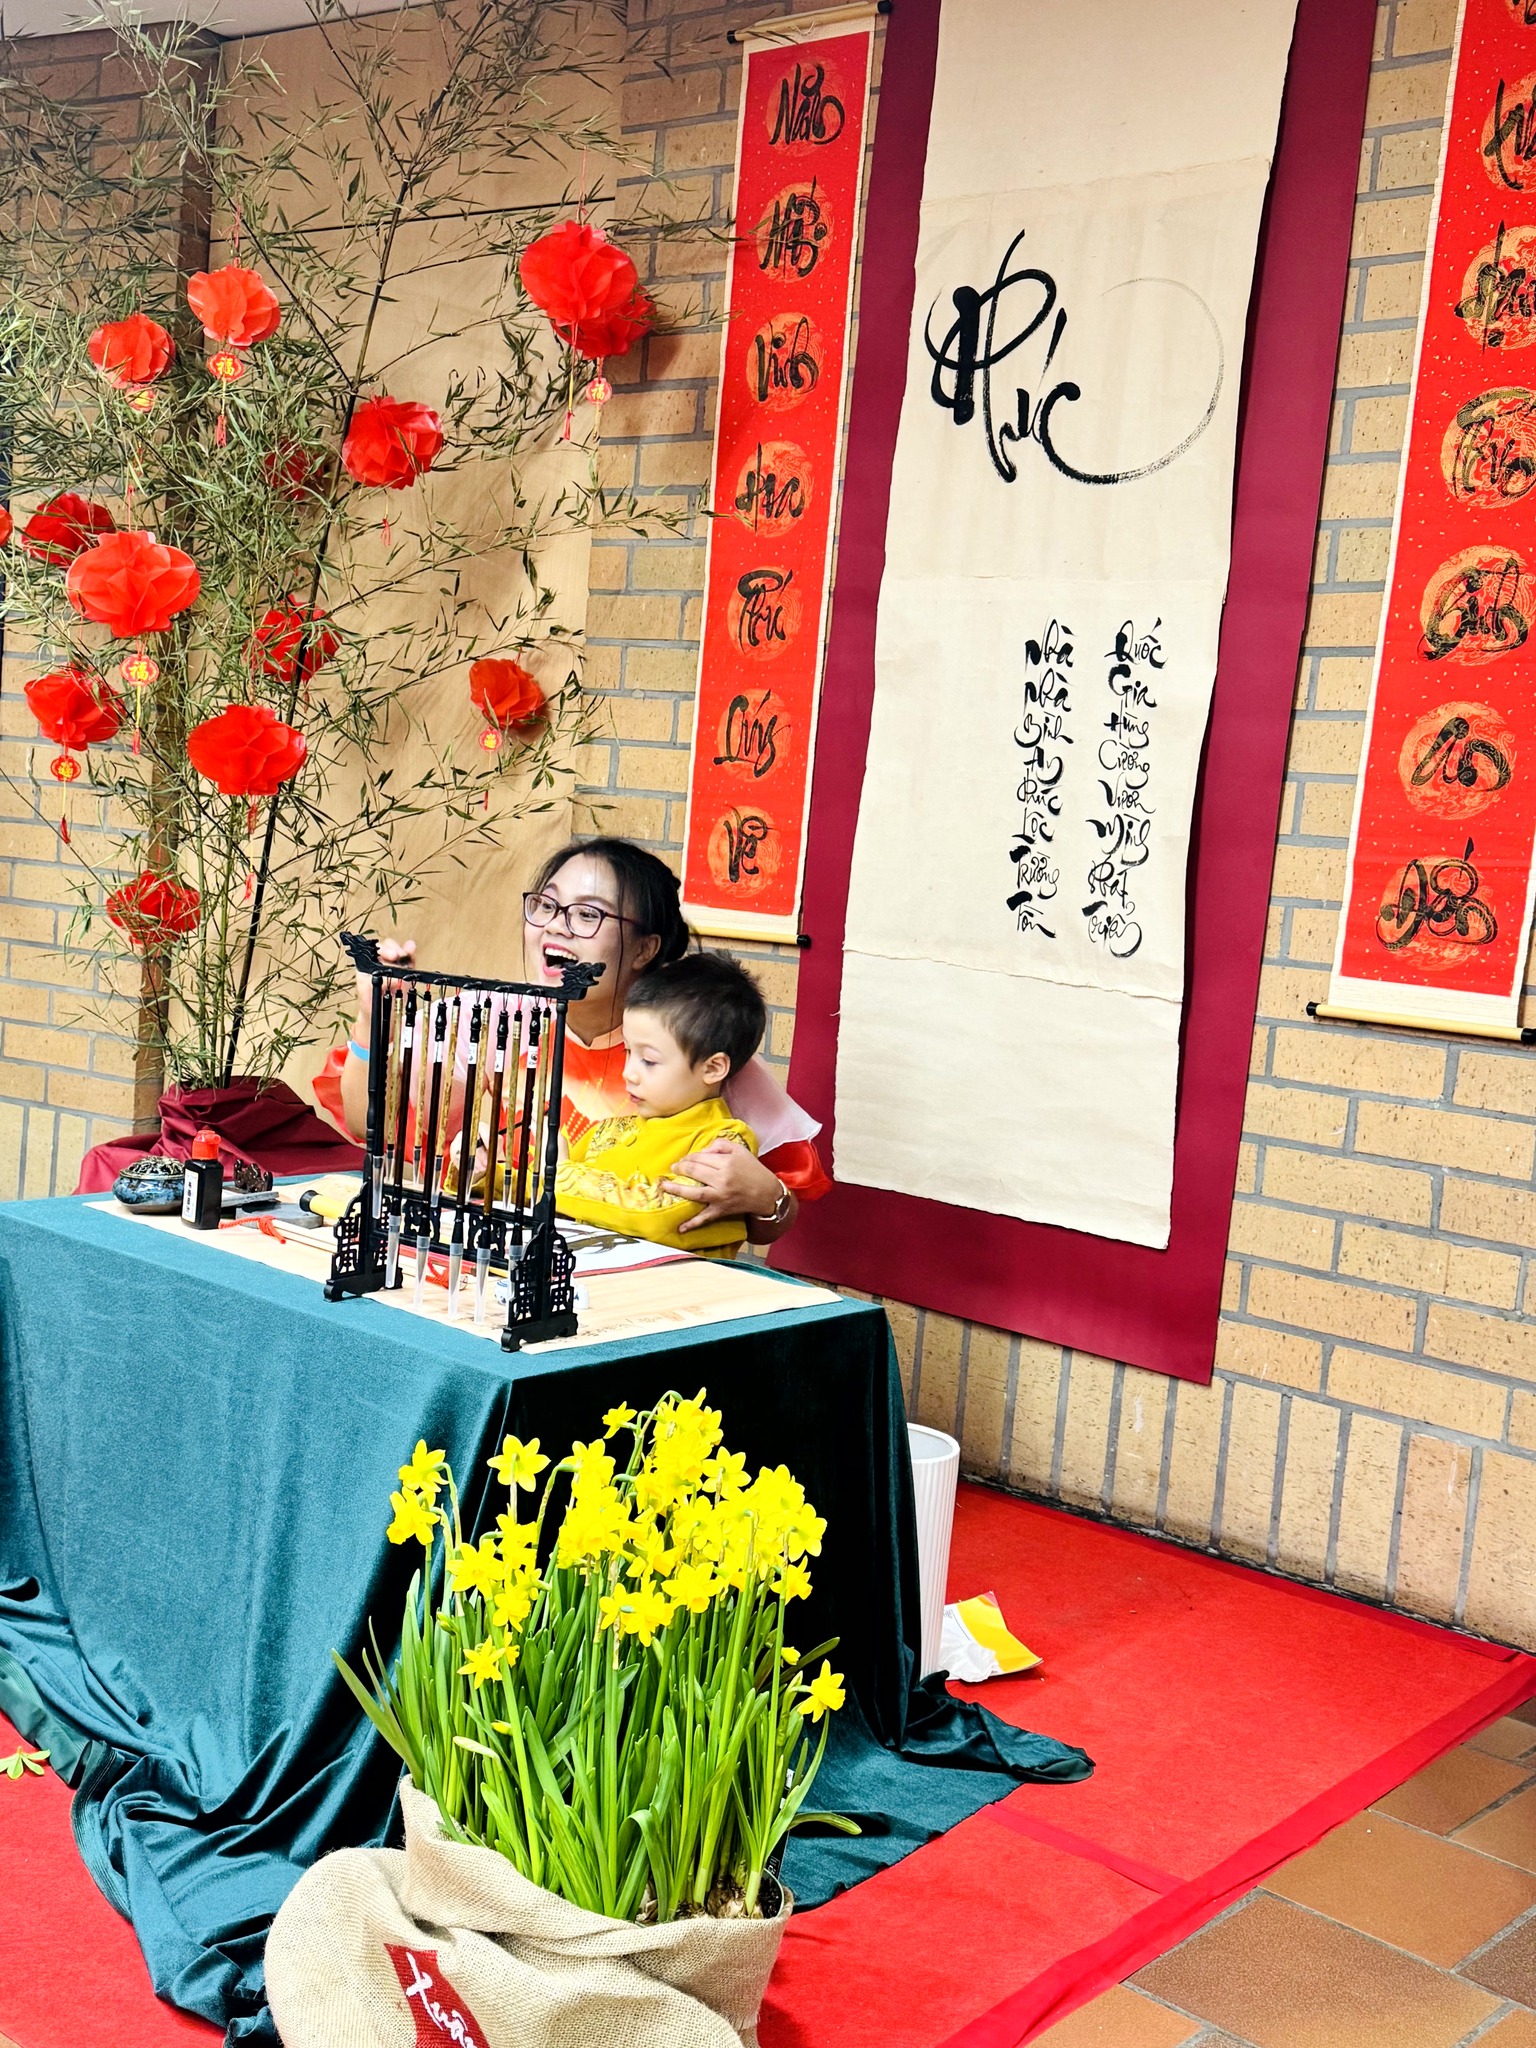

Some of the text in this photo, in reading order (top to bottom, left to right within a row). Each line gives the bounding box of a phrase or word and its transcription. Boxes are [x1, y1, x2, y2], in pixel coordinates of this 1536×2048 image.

[924, 228, 1224, 485] Phúc
[1025, 616, 1075, 671] Nhà
[1023, 668, 1073, 717] Nhà
[1014, 711, 1074, 748] Bình
[1023, 746, 1064, 785] An
[1082, 617, 1168, 958] Quốc Gia Hùng Cường Vươn Mình Phát Triển
[1016, 768, 1063, 816] Phúc
[1012, 807, 1055, 845] Lộc
[1006, 891, 1057, 939] Tồn
